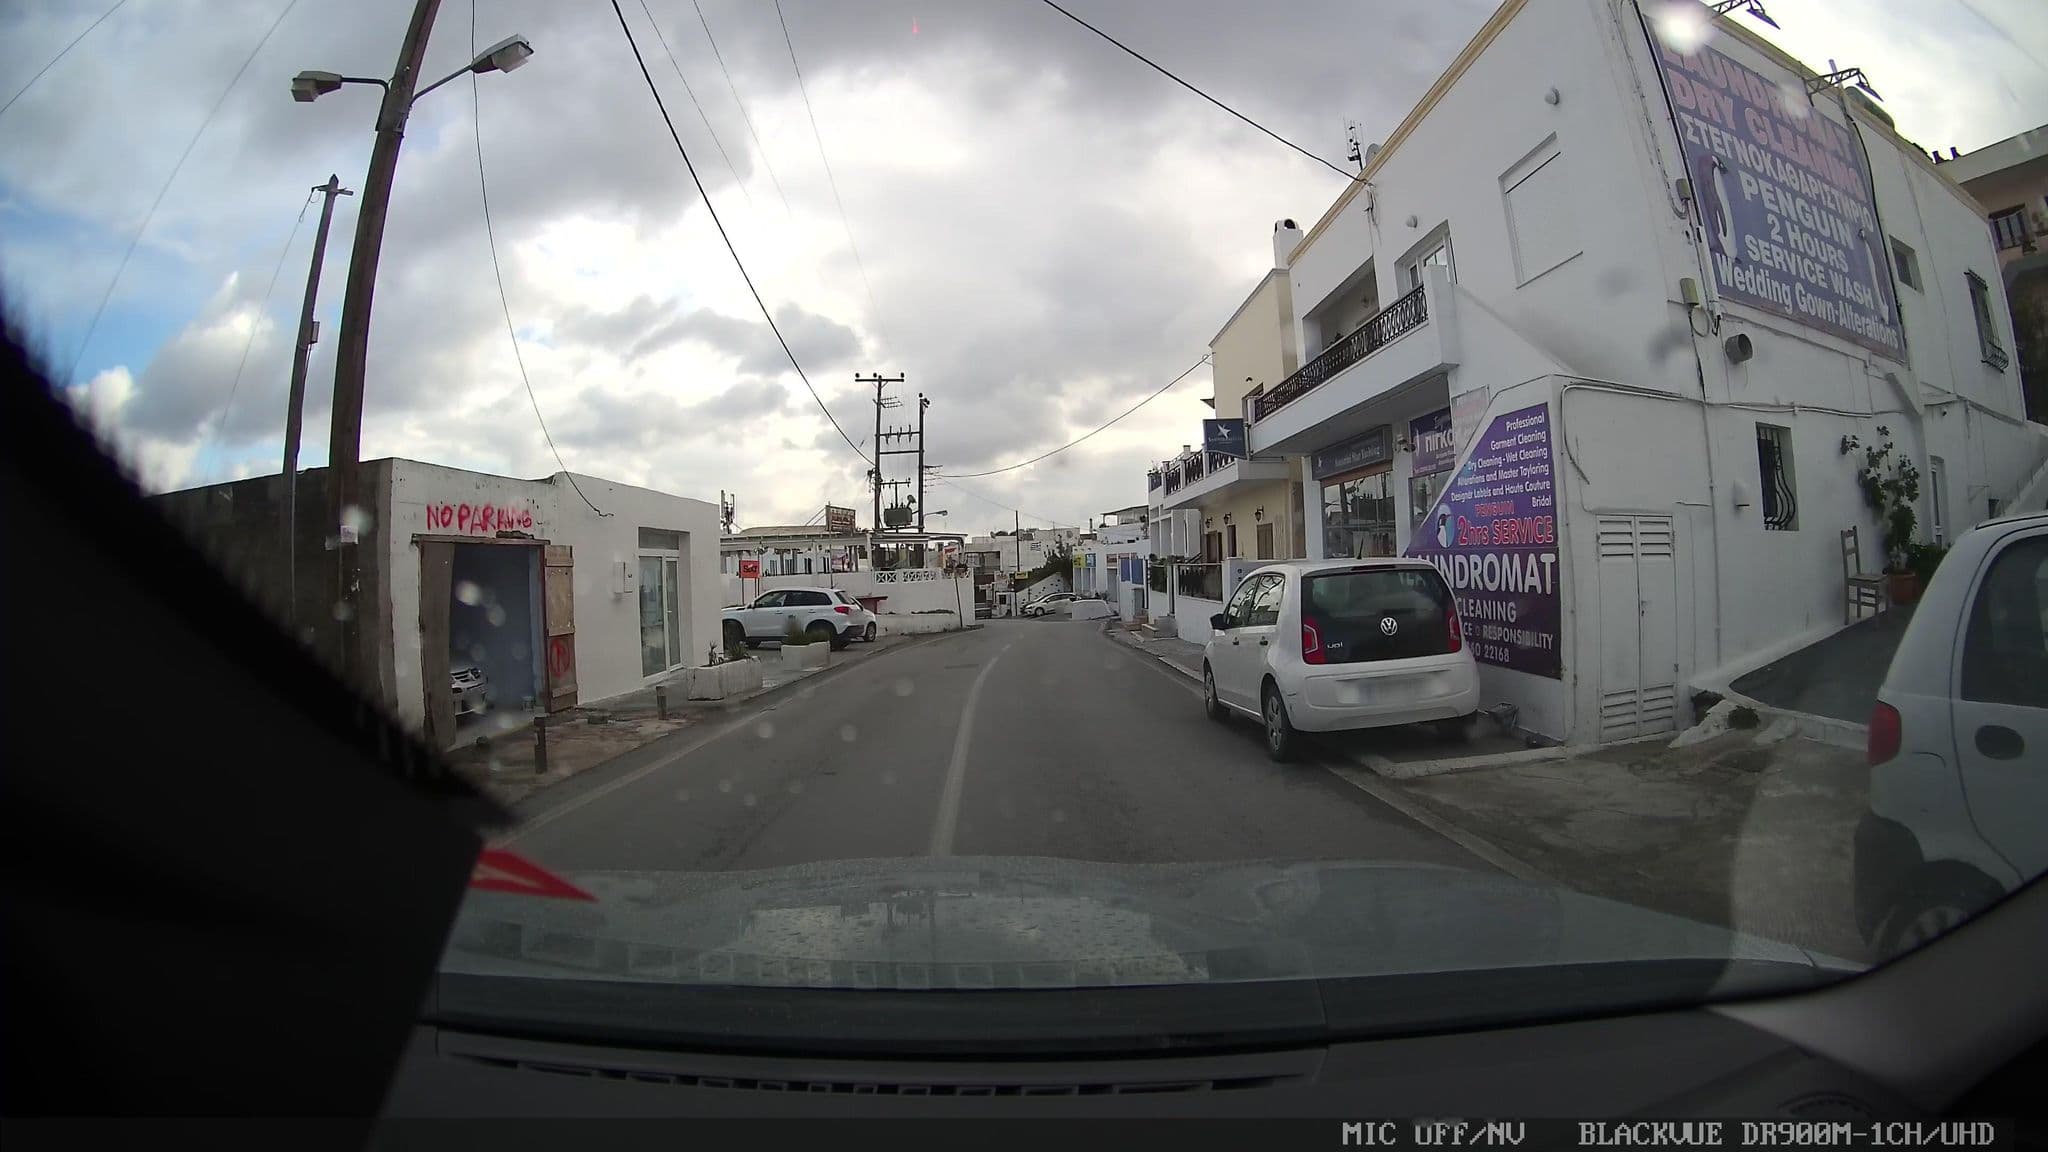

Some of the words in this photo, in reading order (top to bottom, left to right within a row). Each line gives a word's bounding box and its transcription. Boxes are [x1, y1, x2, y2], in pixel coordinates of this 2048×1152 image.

[1667, 68, 1736, 130] DRY
[1744, 107, 1866, 202] CLEANING
[1738, 170, 1854, 249] PENGUIN
[1767, 214, 1783, 243] 2
[1785, 220, 1849, 273] HOURS
[1744, 234, 1828, 289] SERVICE
[1829, 269, 1874, 310] WASH
[1715, 252, 1793, 315] Wedding
[1795, 282, 1898, 349] Gown-Alterations
[1506, 412, 1545, 431] Professional
[1490, 437, 1517, 450] Garment
[1517, 430, 1546, 444] Cleaning
[1477, 455, 1502, 469] Cleaning
[1505, 452, 1518, 463] Wet
[1519, 446, 1548, 460] Cleaning
[1486, 471, 1497, 482] and
[1498, 468, 1519, 480] Master
[1451, 492, 1473, 502] Designer
[1492, 486, 1504, 496] and
[1504, 484, 1524, 495] Haute
[1524, 480, 1551, 492] Couture
[1531, 495, 1552, 508] Bridal
[426, 505, 453, 530] NO
[457, 503, 532, 534] PARKING
[1475, 501, 1515, 517] PENGUIN
[1458, 515, 1490, 546] 2hrs
[1492, 515, 1554, 545] SERVICE
[1457, 598, 1517, 623] CLEANING
[1482, 625, 1554, 650] RESPONSIBILITY
[1484, 644, 1510, 662] 22168
